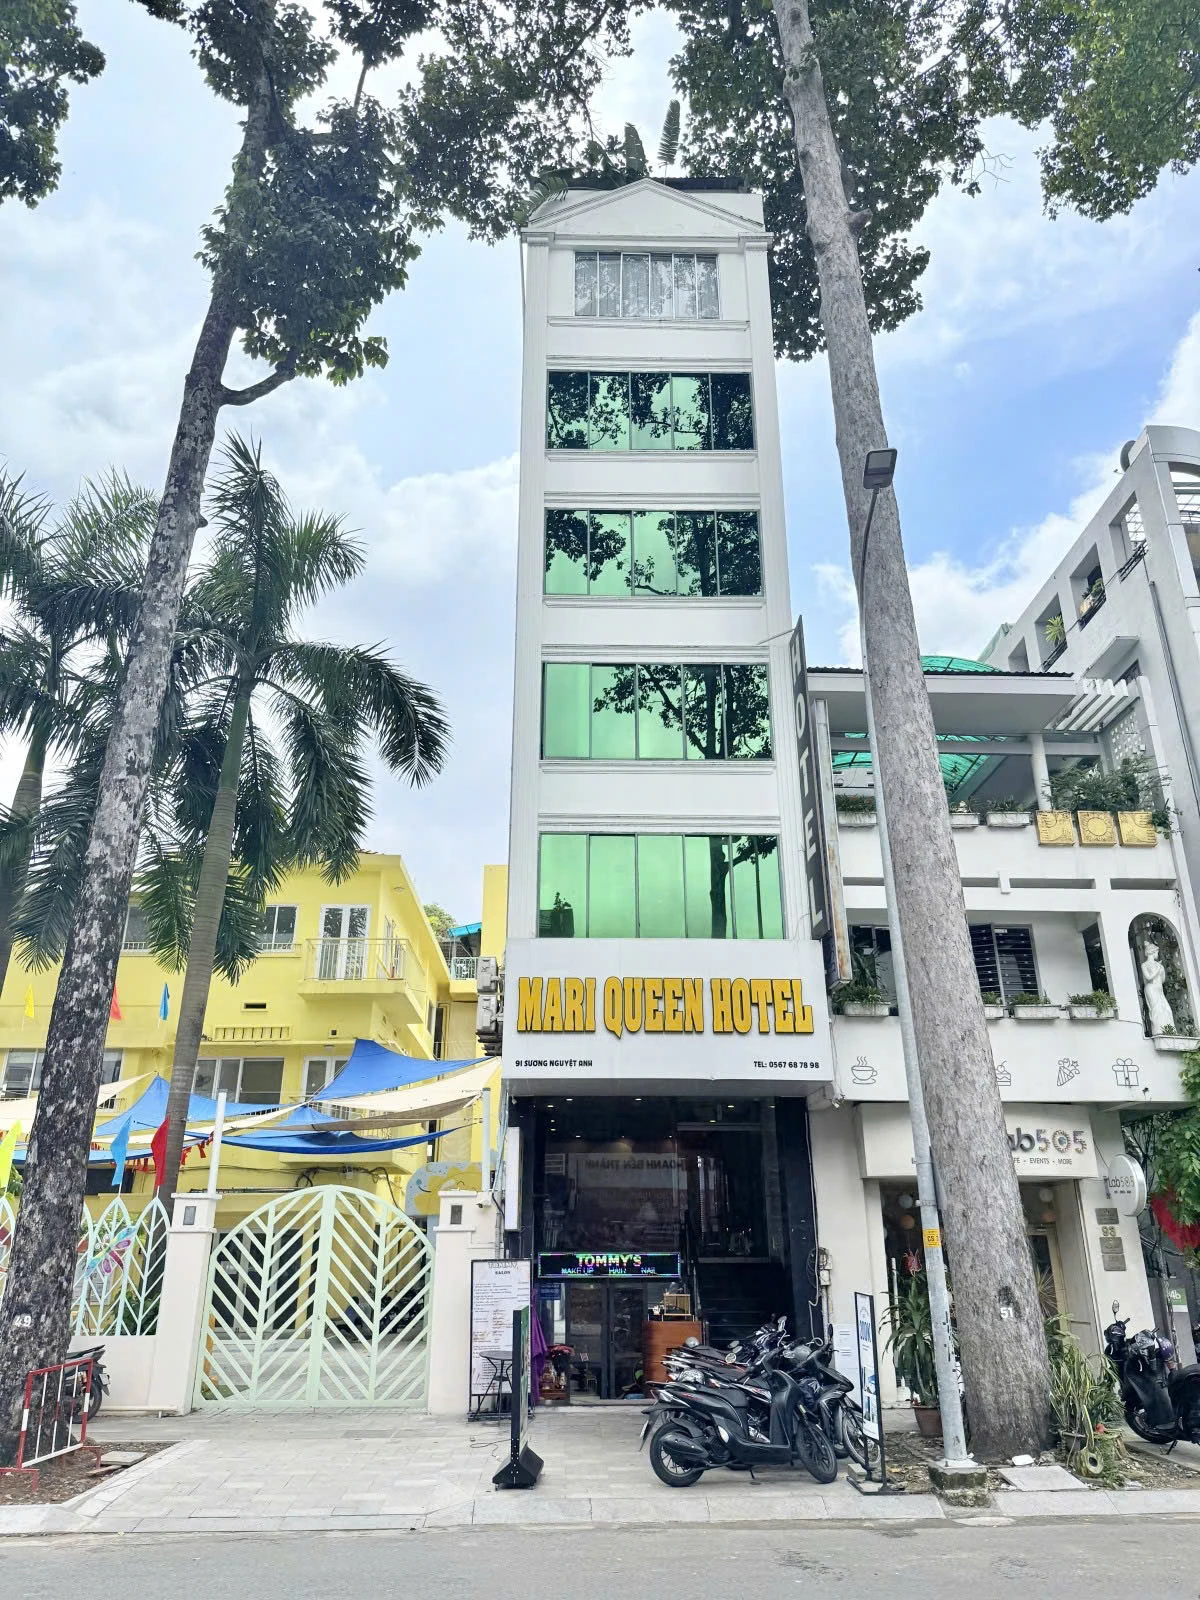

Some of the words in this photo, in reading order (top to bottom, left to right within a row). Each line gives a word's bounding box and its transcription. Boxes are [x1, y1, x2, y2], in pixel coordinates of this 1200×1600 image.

[791, 631, 823, 926] HOTEL
[517, 977, 596, 1033] MARI
[603, 976, 704, 1039] QUEEN
[711, 978, 814, 1034] HOTEL
[515, 1059, 523, 1067] 91
[753, 1060, 768, 1068] TEL:
[788, 1061, 798, 1069] 68
[799, 1061, 808, 1069] 78
[809, 1061, 820, 1069] 98
[1029, 1157, 1050, 1165] EVENTS
[1101, 1225, 1116, 1237] 93
[576, 1254, 642, 1267] TOMMY'S
[1000, 1307, 1014, 1318] 51
[13, 1314, 32, 1327] 49
